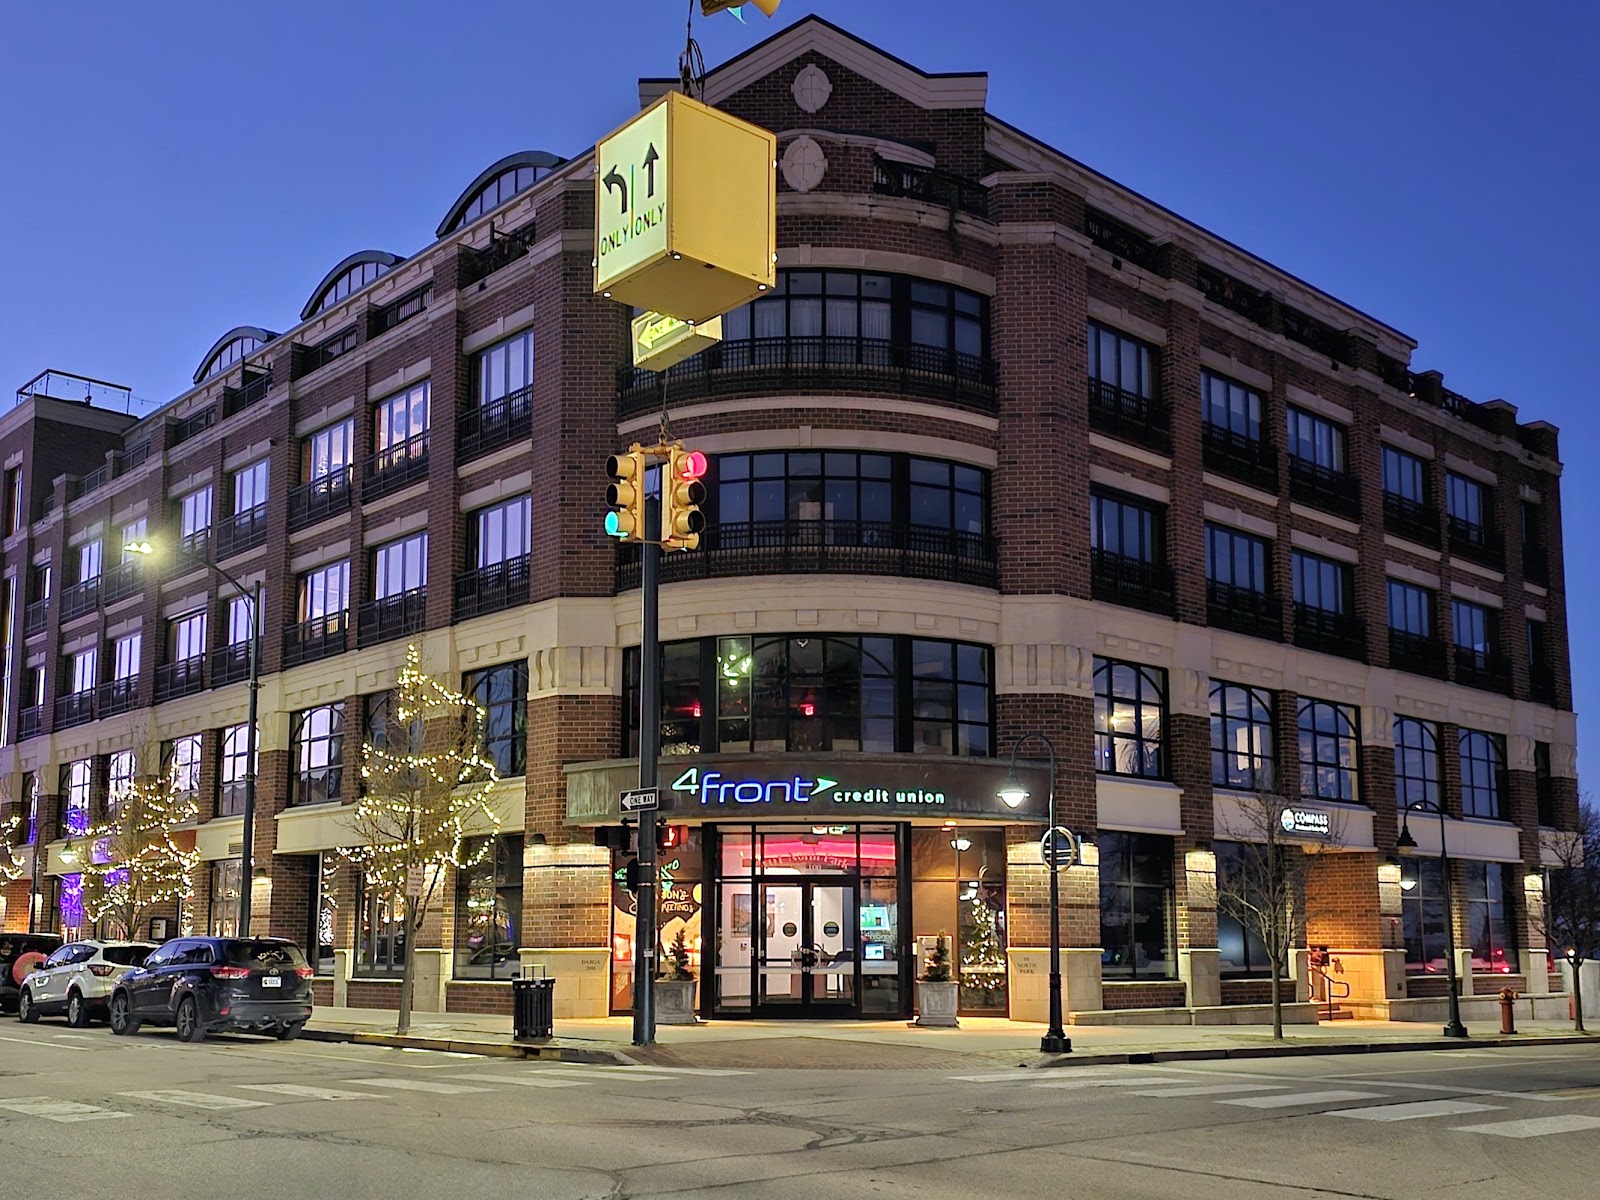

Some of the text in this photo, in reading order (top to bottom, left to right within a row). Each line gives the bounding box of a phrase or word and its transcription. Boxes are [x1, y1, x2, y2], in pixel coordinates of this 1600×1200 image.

[635, 202, 665, 236] ONLY
[600, 225, 629, 256] ONLY
[671, 767, 945, 804] 4front credit union
[630, 794, 654, 805] ONE WAY
[1294, 811, 1328, 826] COMPASS
[661, 902, 694, 913] REETINGS
